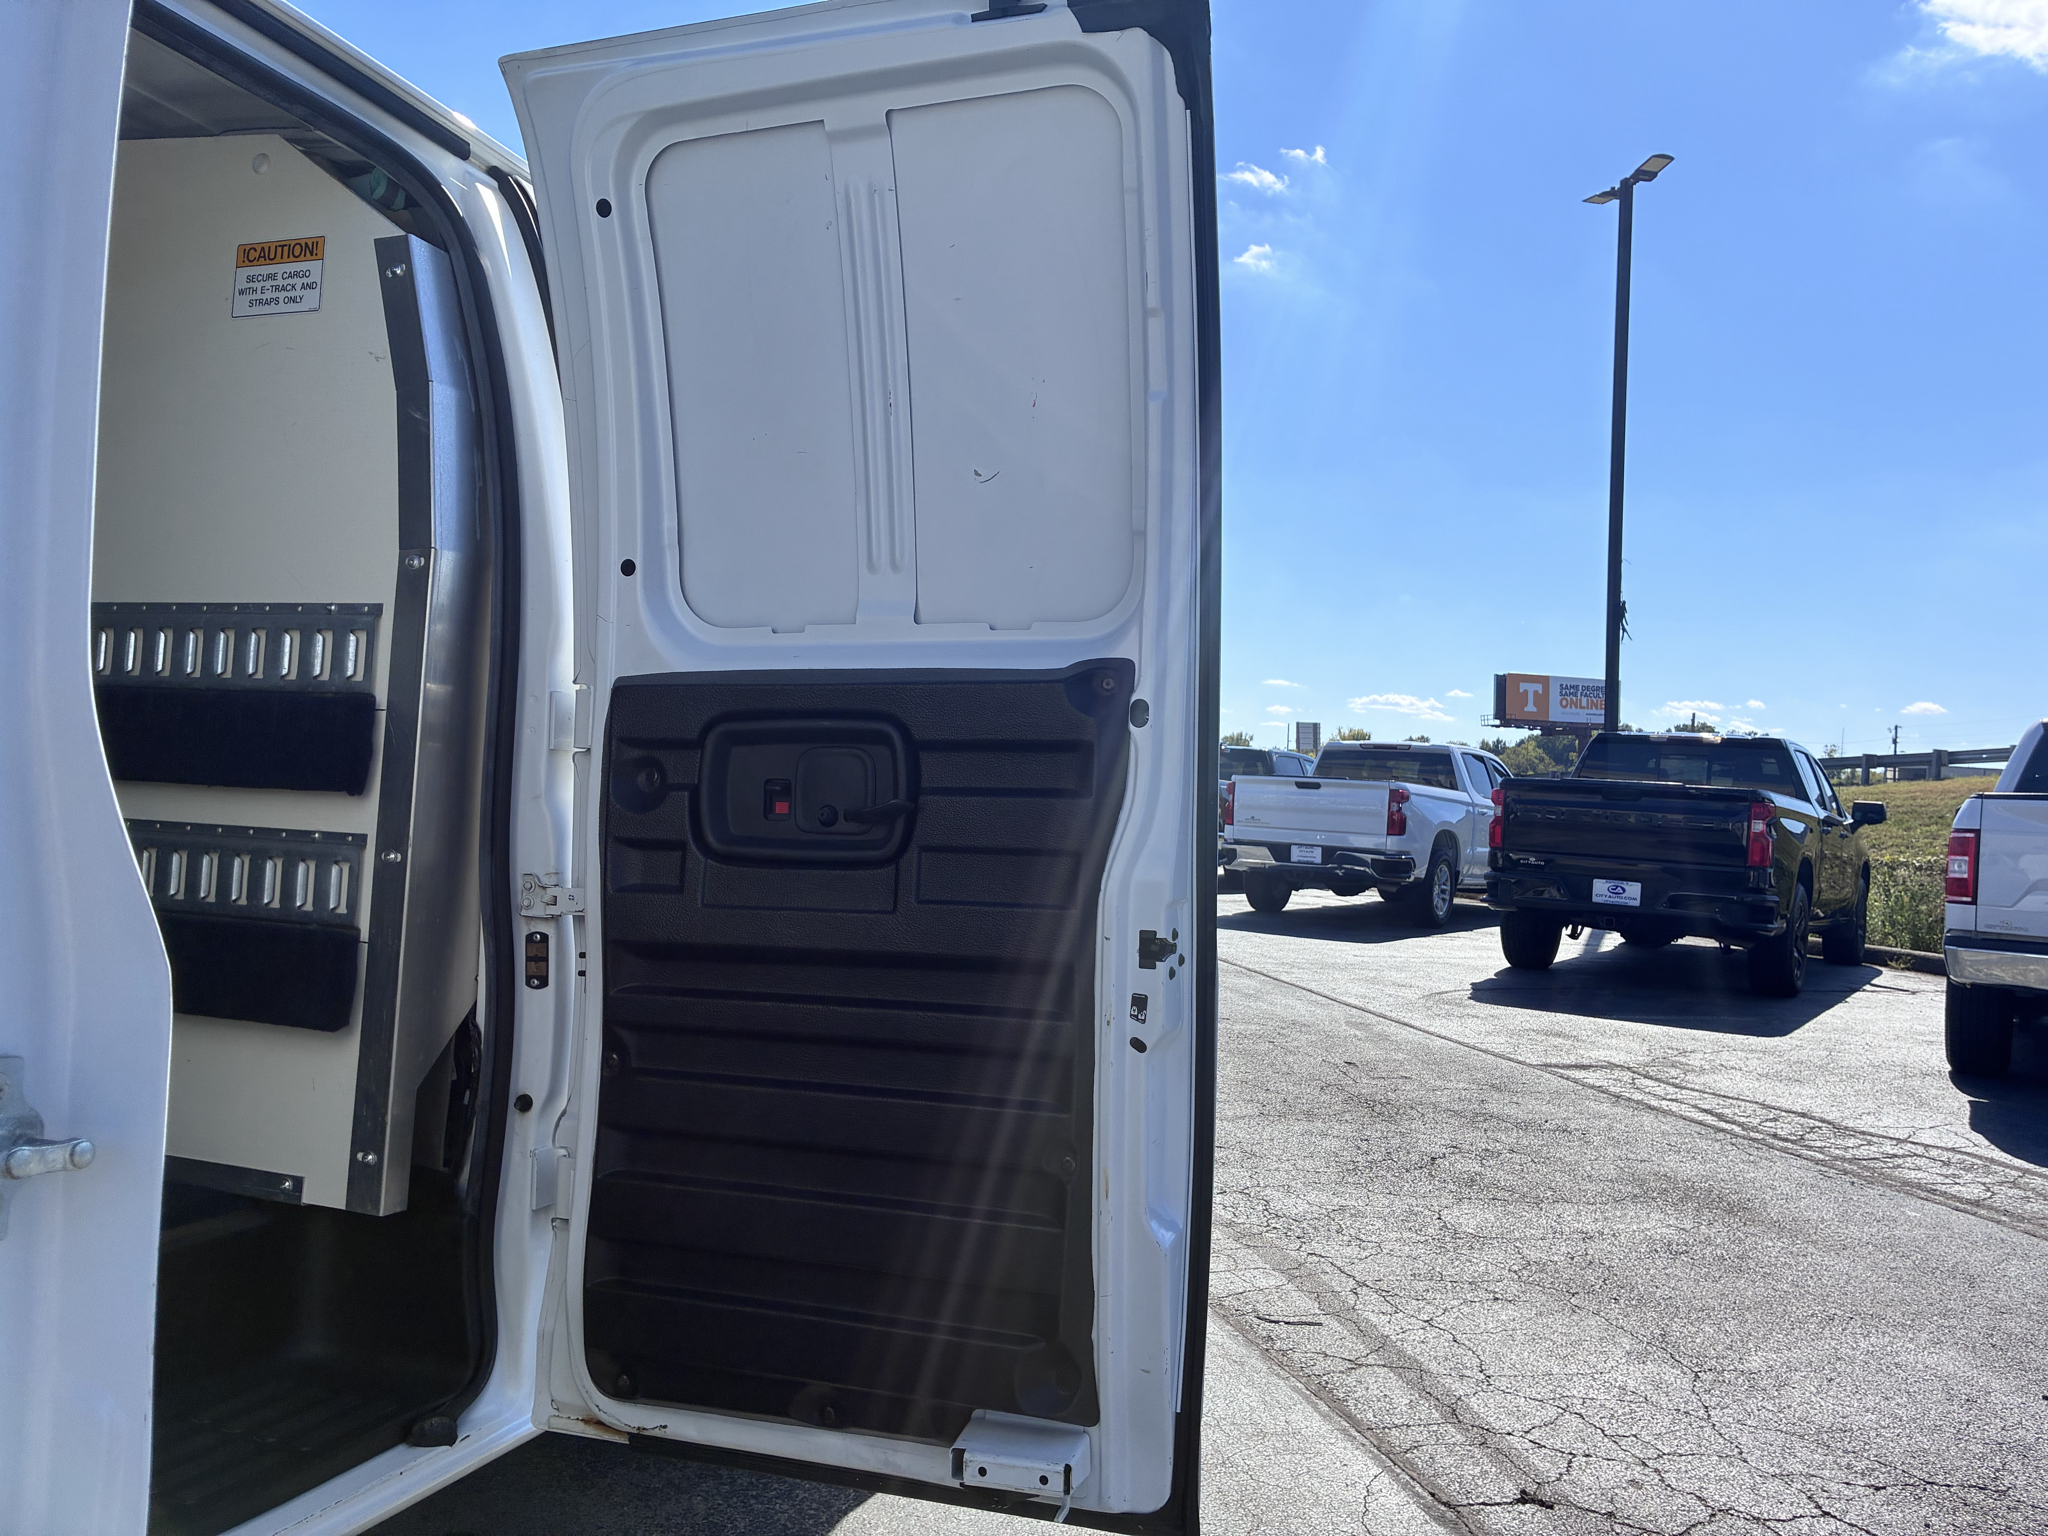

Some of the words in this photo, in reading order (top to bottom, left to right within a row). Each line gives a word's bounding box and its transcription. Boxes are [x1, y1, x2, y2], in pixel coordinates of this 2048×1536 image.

[242, 241, 319, 263] !CAUTION!
[245, 272, 278, 284] SECURE
[281, 269, 311, 280] CARGO
[238, 286, 258, 296] WITH
[260, 282, 297, 294] E-TRACK
[299, 281, 318, 291] AND
[248, 296, 280, 308] STRAPS
[283, 294, 304, 305] ONLY
[1519, 682, 1543, 712] T
[1559, 697, 1606, 711] ONLINE
